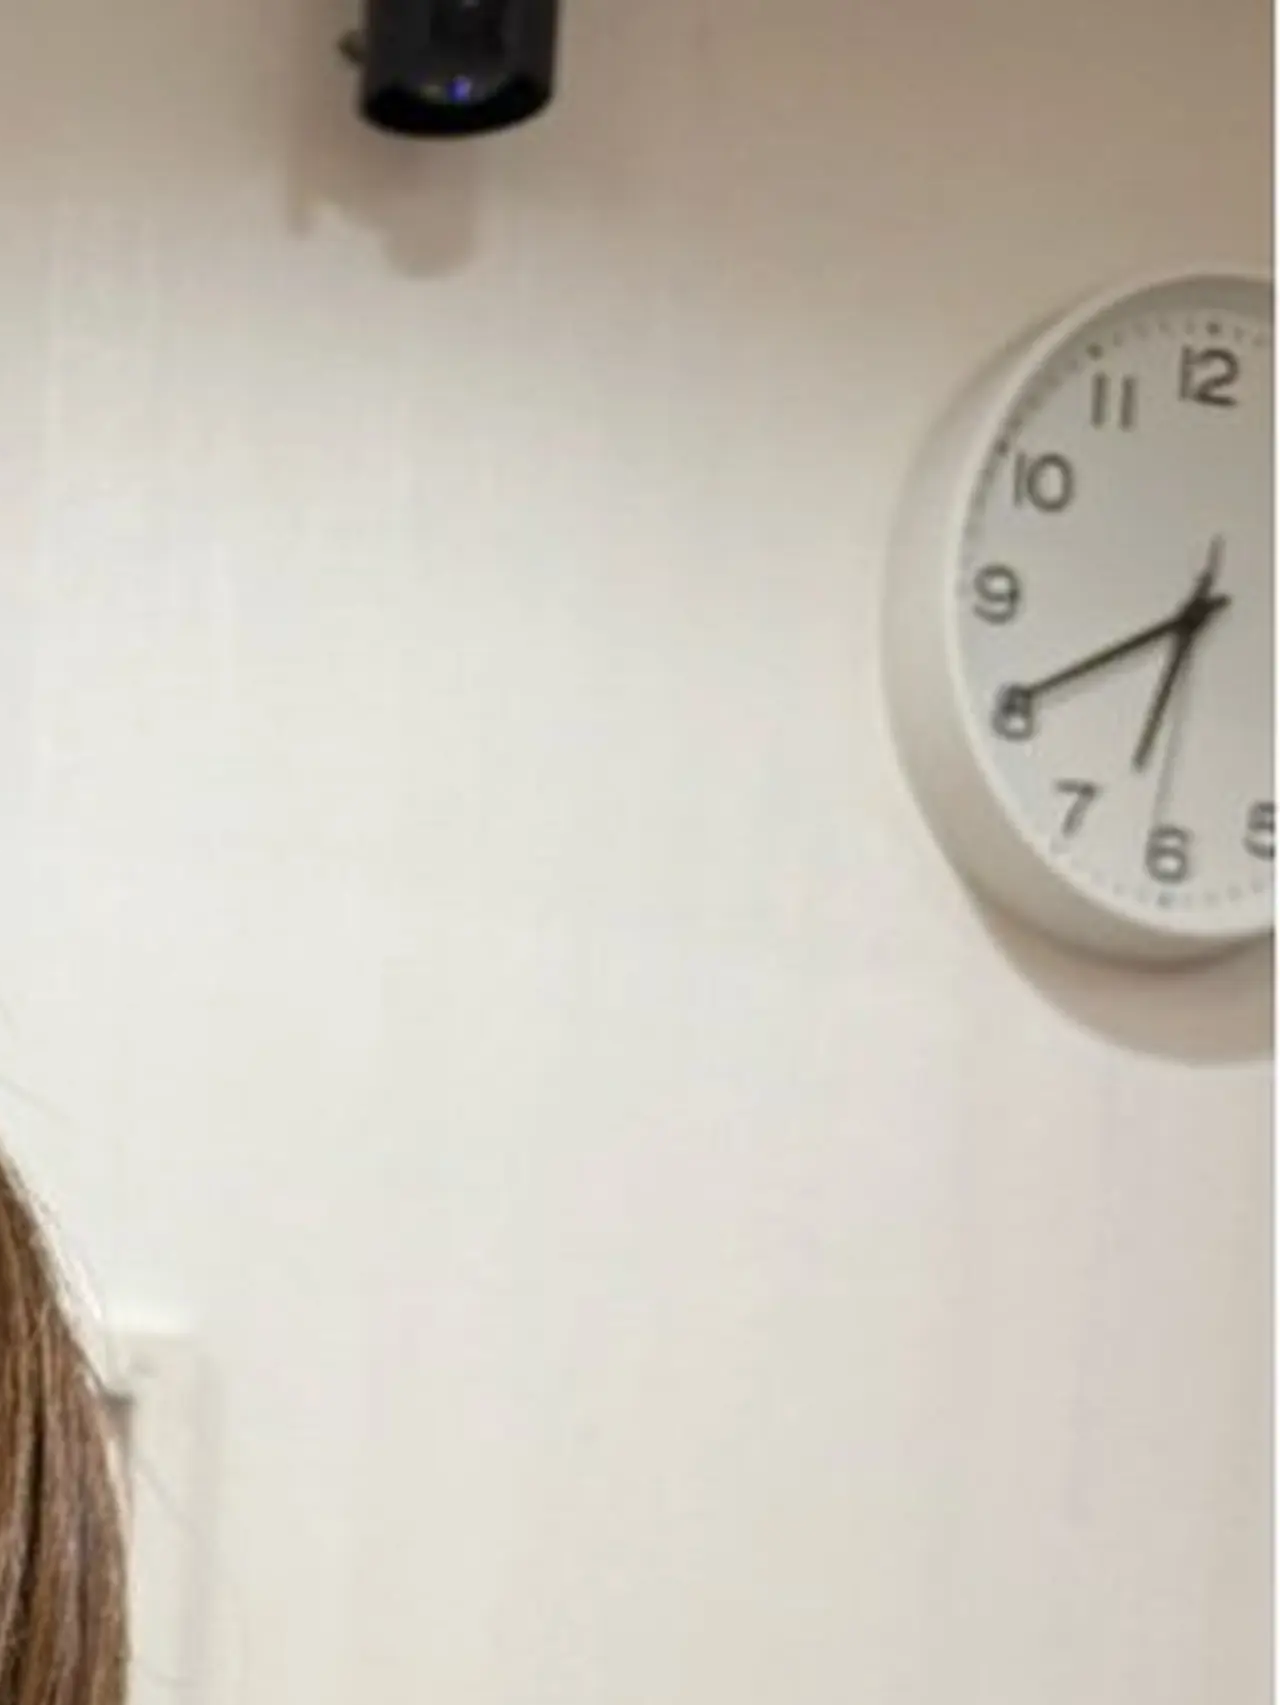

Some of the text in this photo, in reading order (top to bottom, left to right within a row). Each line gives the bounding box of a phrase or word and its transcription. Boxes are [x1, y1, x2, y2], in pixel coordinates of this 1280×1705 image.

[1090, 372, 1136, 431] 11
[1178, 346, 1240, 407] 12
[1013, 452, 1074, 513] 10
[972, 564, 1021, 626] 9
[992, 682, 1036, 742] 8
[1052, 778, 1100, 840] 7
[1145, 825, 1192, 885] 6
